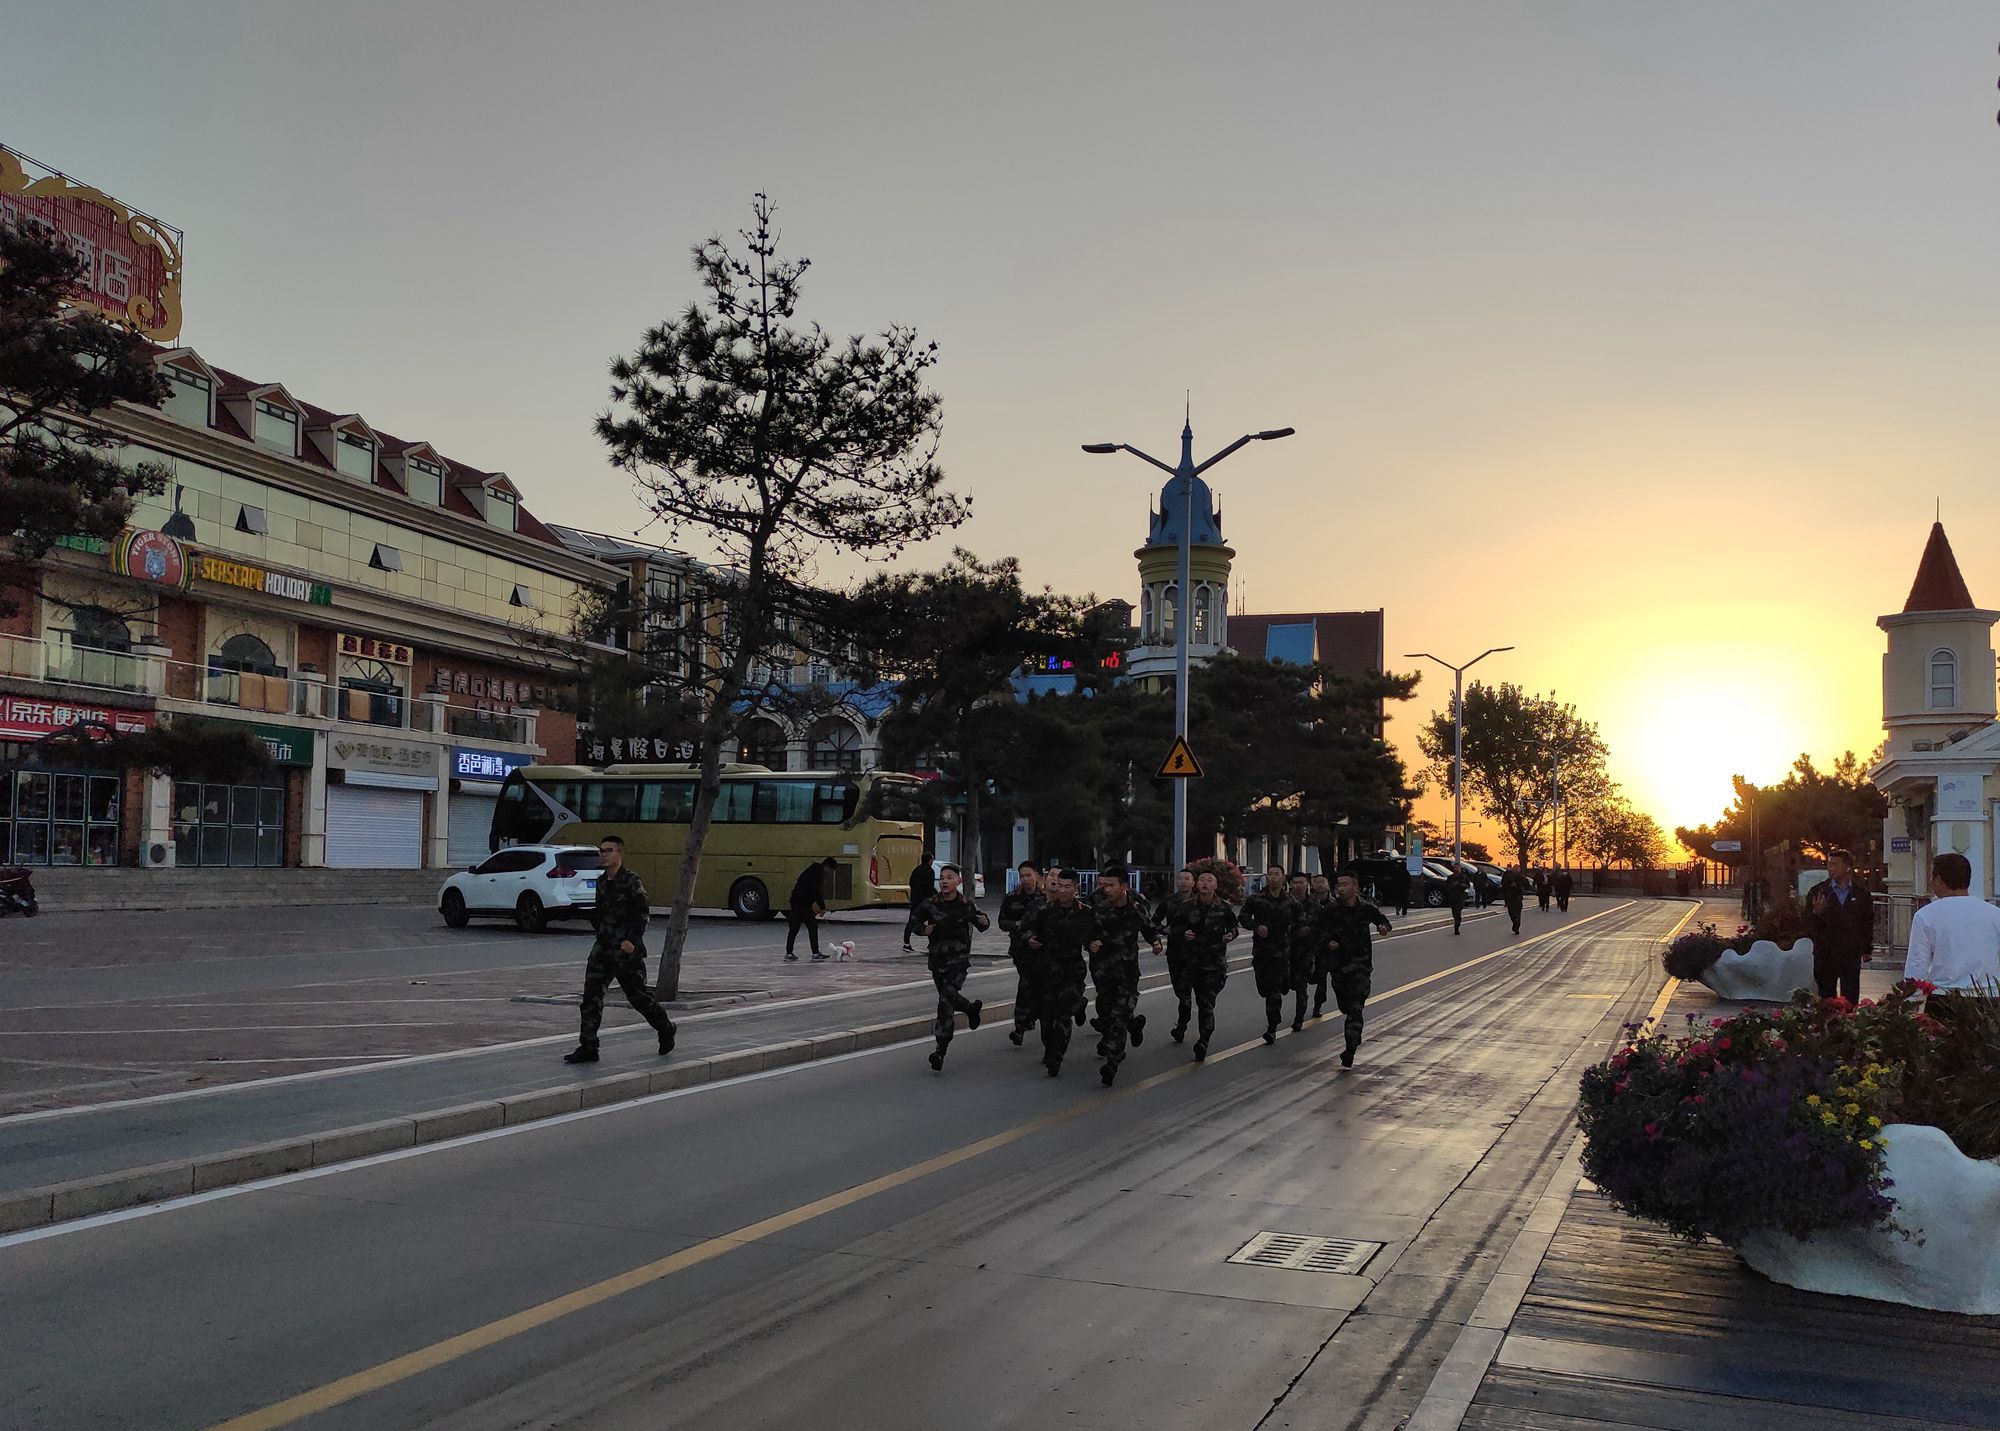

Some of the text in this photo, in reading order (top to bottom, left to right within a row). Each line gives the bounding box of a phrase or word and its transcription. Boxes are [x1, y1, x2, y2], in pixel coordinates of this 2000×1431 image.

[131, 530, 156, 556] TIGER
[157, 533, 180, 566] STONE
[265, 572, 313, 603] HOLIDAY
[584, 735, 704, 762] 海景假日酒
